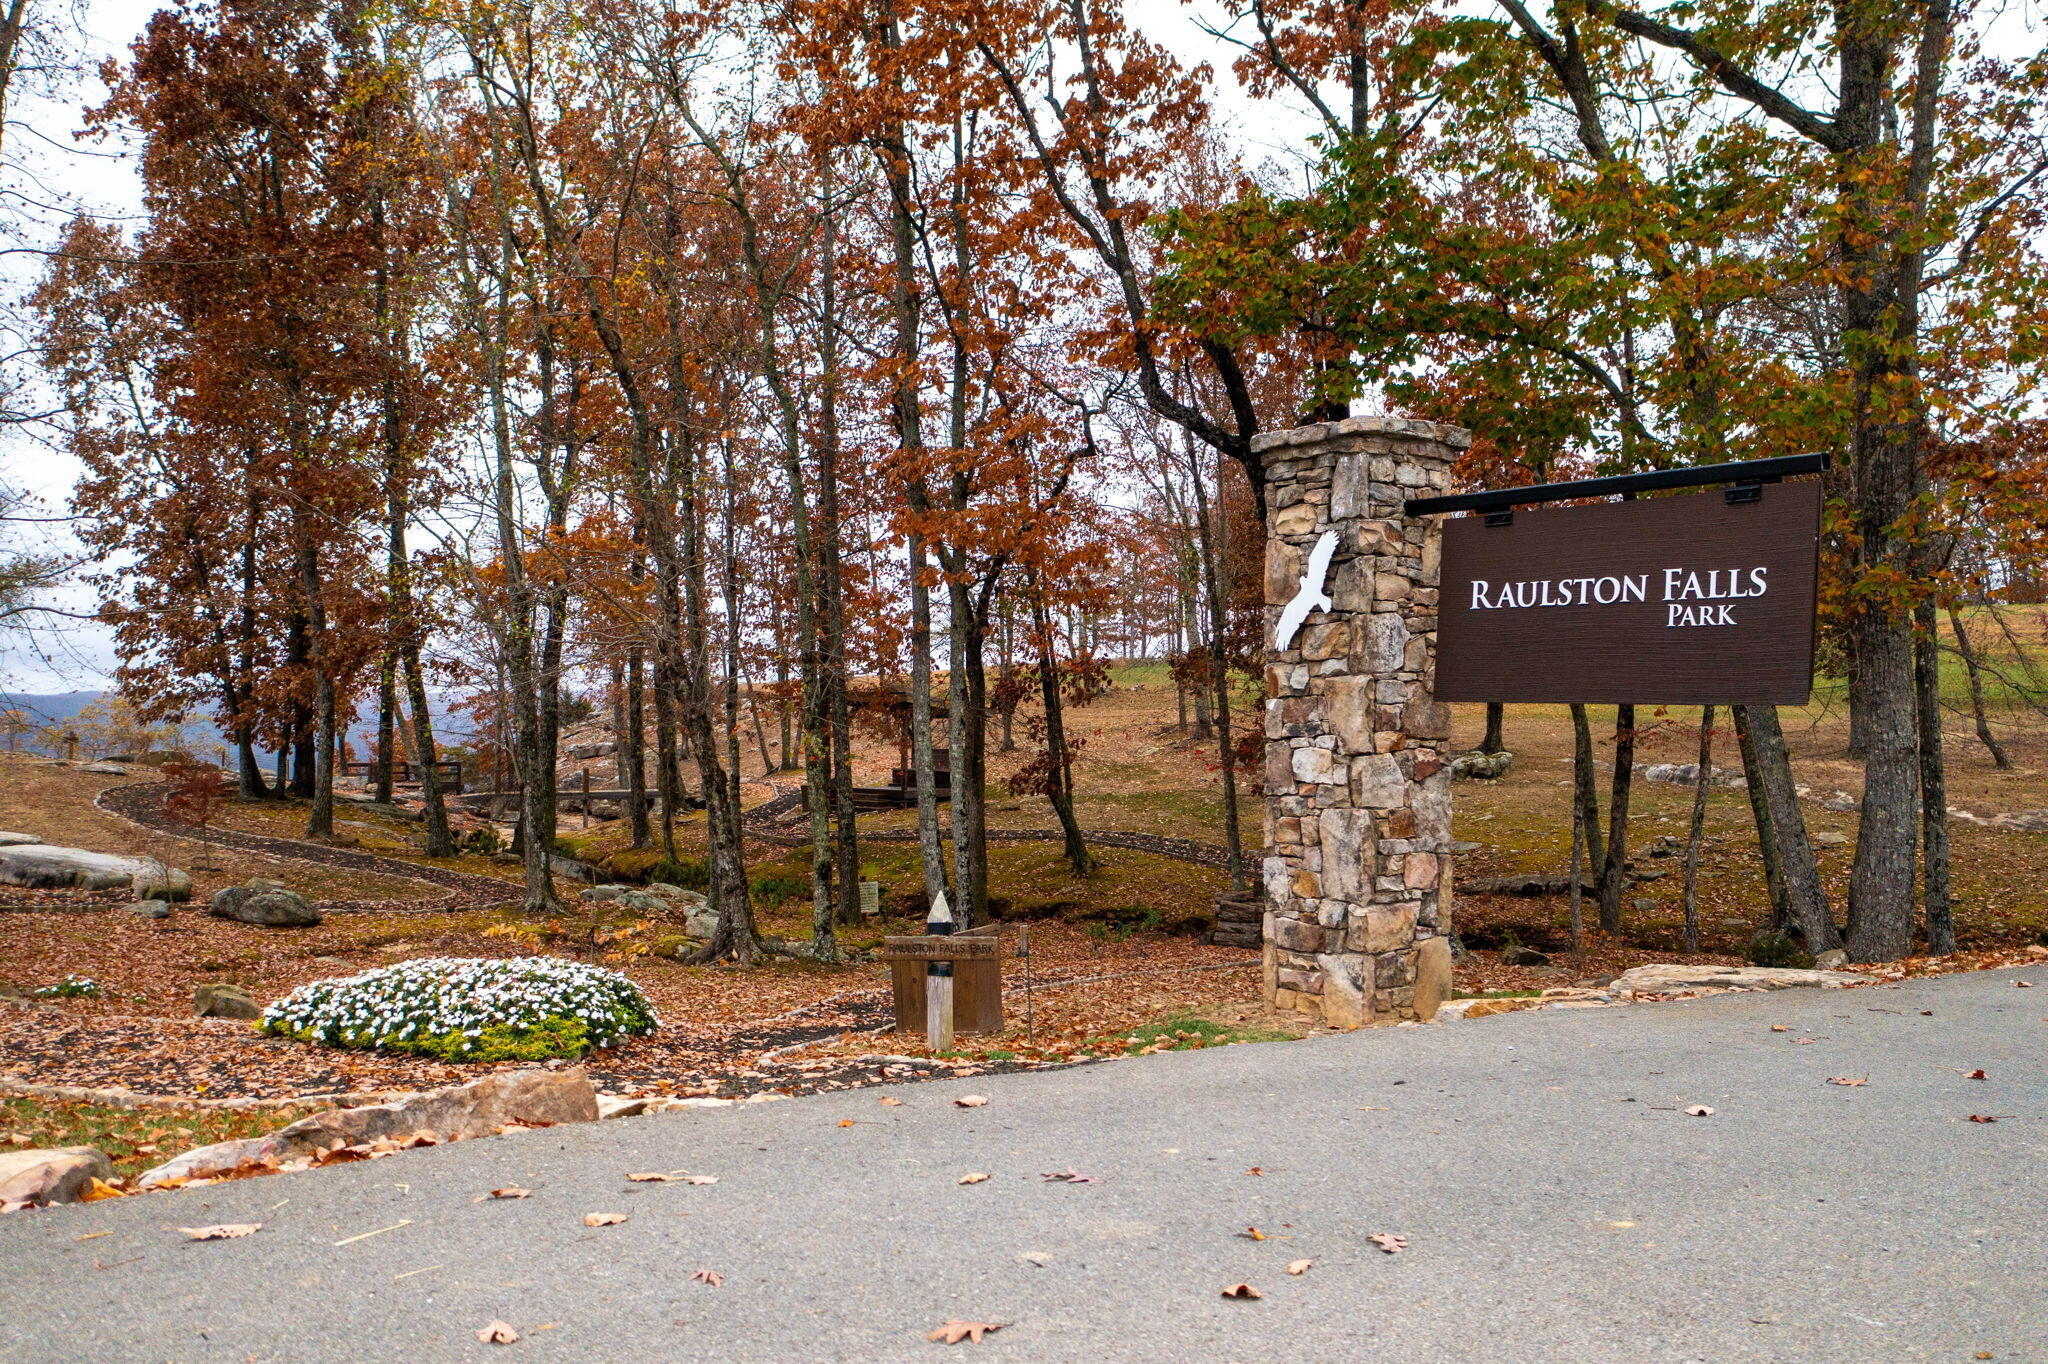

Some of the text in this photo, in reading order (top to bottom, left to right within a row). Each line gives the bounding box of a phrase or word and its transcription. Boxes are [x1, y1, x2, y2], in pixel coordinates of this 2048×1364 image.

[1469, 566, 1768, 610] RAULSTON FALLS
[1666, 603, 1738, 628] PARK
[888, 943, 994, 954] RAULSTON FALLS PARK
